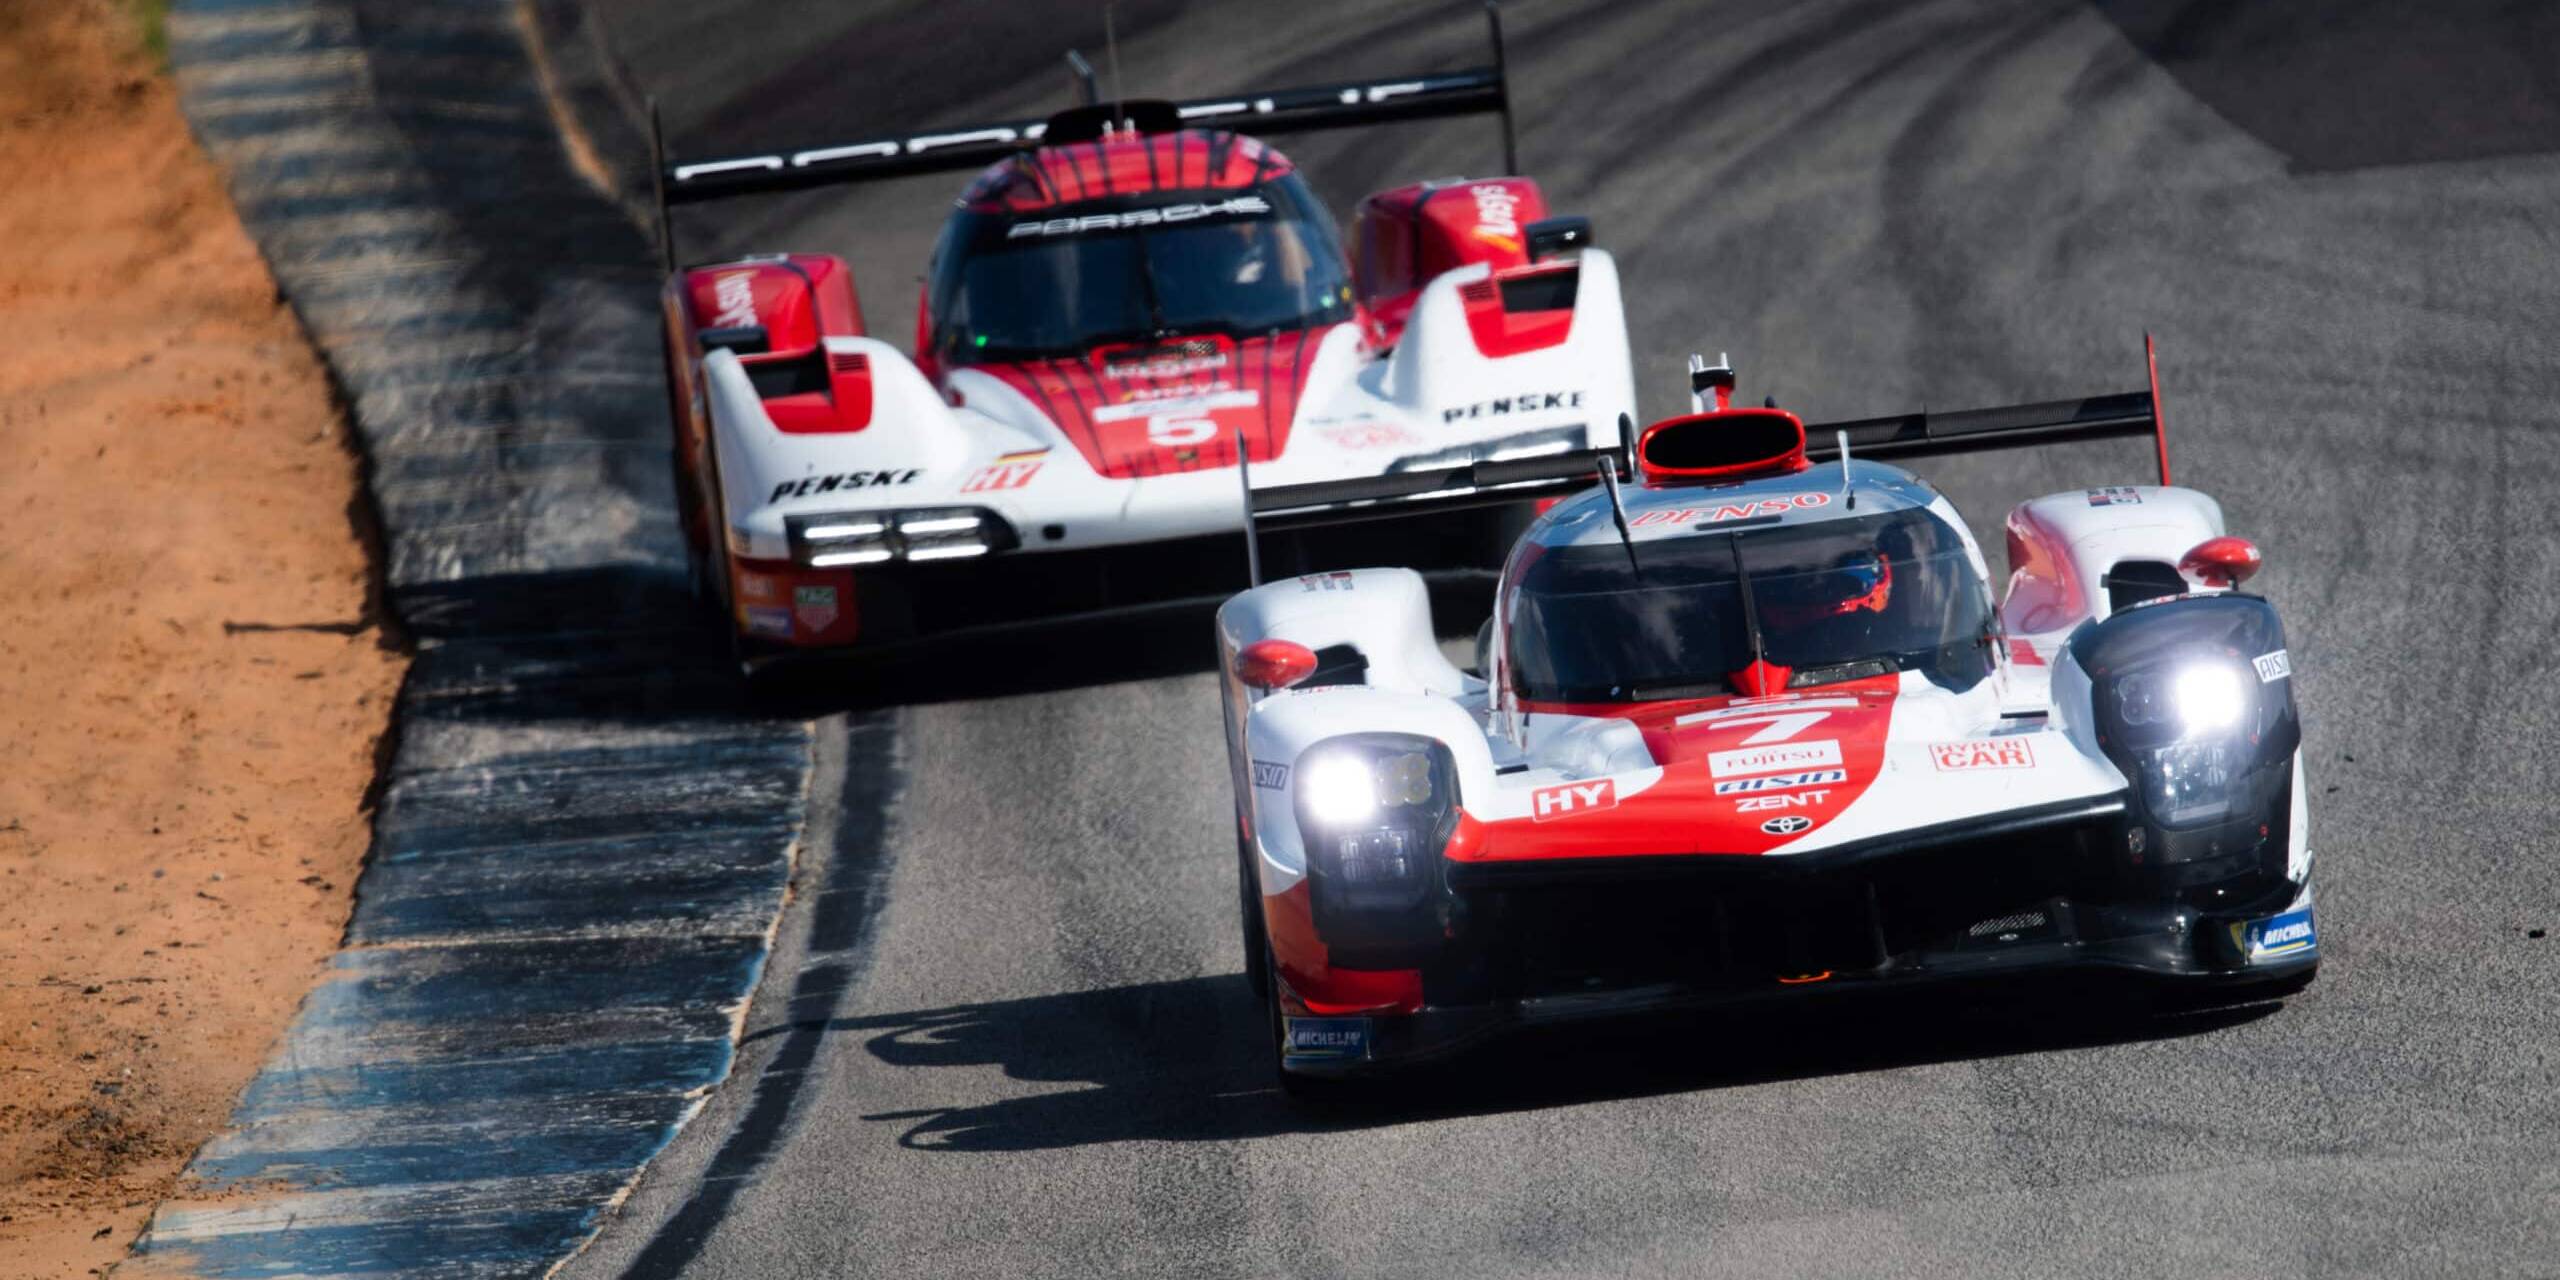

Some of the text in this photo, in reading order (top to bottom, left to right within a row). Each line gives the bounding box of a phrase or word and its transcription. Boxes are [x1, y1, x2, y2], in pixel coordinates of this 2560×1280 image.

[1007, 196, 1269, 237] PORSCHE
[1442, 390, 1586, 424] PENSKE
[1147, 411, 1218, 446] 5
[768, 469, 928, 505] PENSKE
[964, 464, 1040, 492] HY
[1631, 492, 1832, 528] DENSO
[1708, 711, 1832, 745] 7
[1725, 748, 1826, 770] FUJITSU
[1936, 739, 2021, 754] HYPER
[1941, 749, 2025, 769] CAR
[1538, 783, 1609, 816] HY
[1735, 791, 1831, 813] ZENT
[1296, 1031, 1361, 1047] MICHELIN
